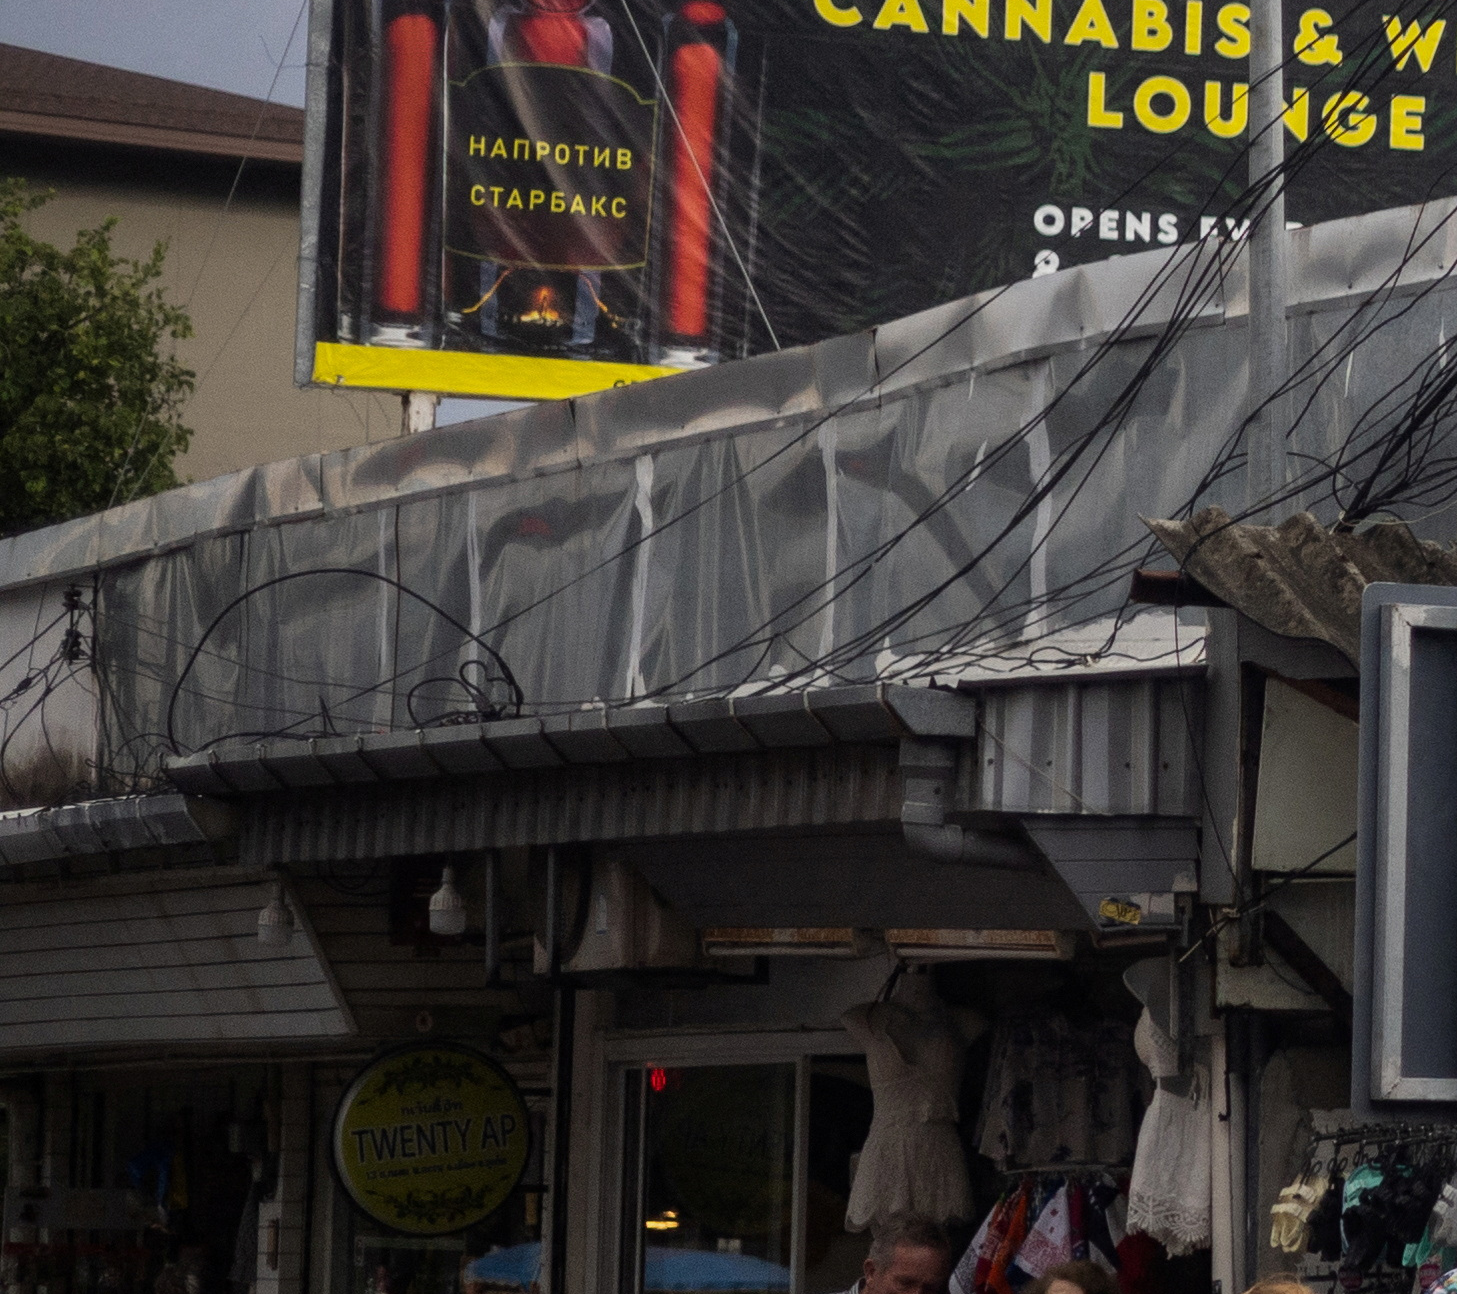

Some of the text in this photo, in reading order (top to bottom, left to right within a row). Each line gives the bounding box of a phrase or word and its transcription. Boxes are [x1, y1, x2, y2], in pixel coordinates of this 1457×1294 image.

[1293, 9, 1342, 67] &
[1087, 72, 1426, 152] LOUNGE
[467, 134, 634, 172] НАПРОТИВ
[469, 184, 628, 220] СТАРБАКС
[1033, 204, 1180, 245] OPENS
[352, 1118, 472, 1163] TWENTY
